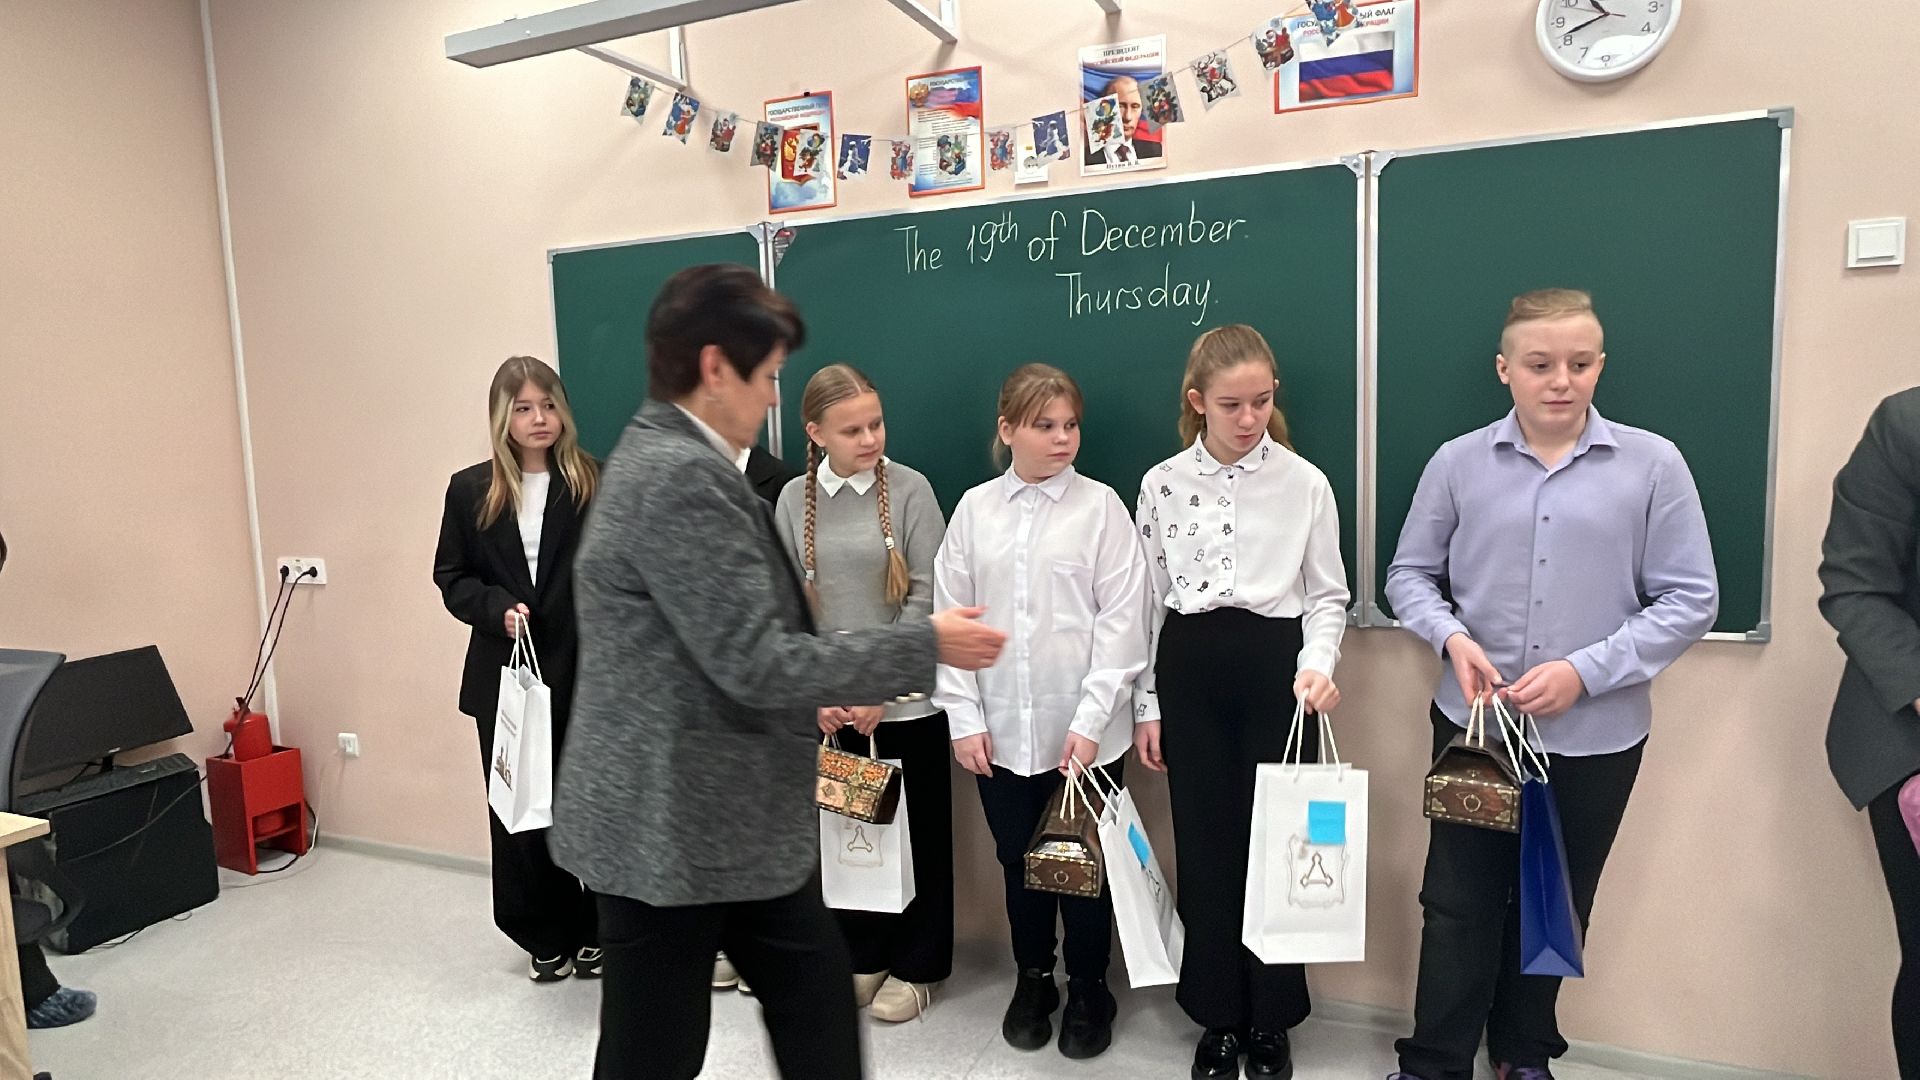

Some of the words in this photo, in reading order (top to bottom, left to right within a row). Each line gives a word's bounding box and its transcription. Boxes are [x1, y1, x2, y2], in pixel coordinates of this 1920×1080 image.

[1375, 7, 1396, 17] ФЛАГ
[1648, 1, 1658, 13] 3
[1555, 16, 1565, 28] 9
[1641, 21, 1651, 33] 4
[1563, 34, 1573, 46] 8
[1580, 47, 1589, 58] 7
[894, 225, 943, 275] The
[966, 210, 1019, 264] 19th
[1027, 211, 1067, 262] of
